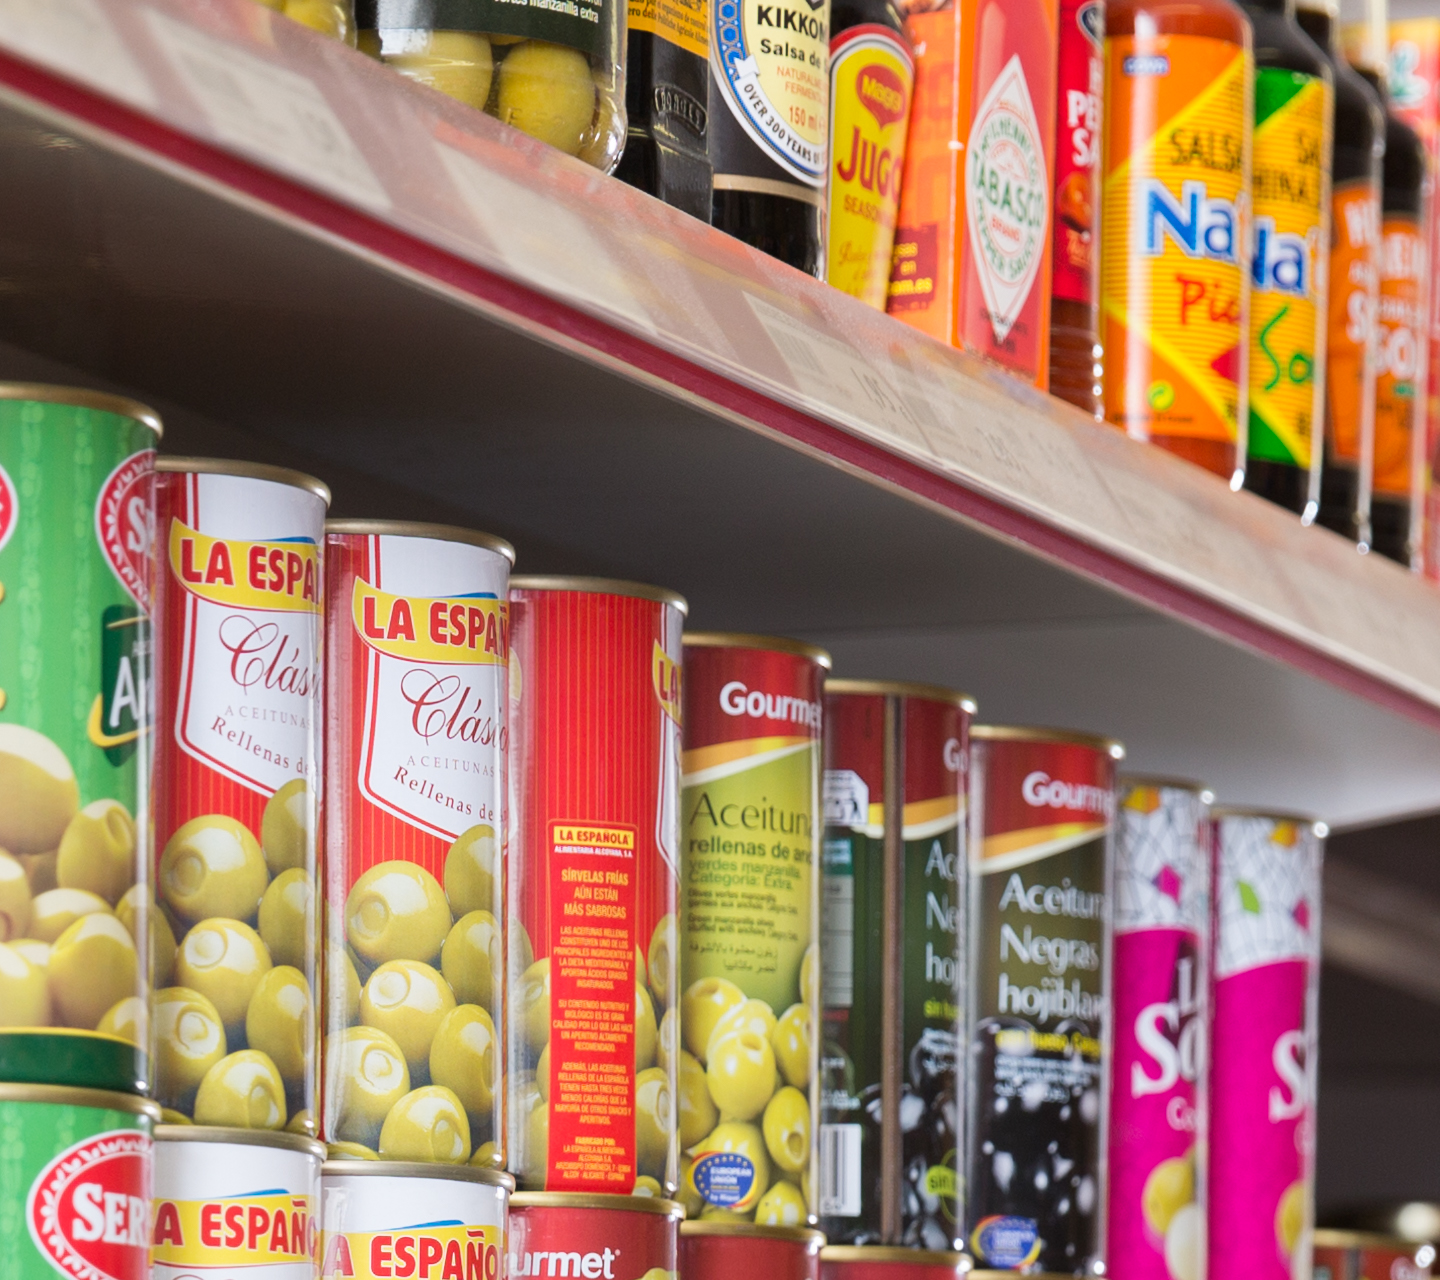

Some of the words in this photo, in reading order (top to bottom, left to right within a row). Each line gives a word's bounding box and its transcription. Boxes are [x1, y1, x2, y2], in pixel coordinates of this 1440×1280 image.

[580, 5, 598, 23] extra
[760, 39, 804, 62] Salsa
[744, 83, 765, 116] OVER
[765, 115, 785, 141] 300
[787, 134, 812, 162] YEARS
[789, 106, 806, 126] 150
[181, 538, 234, 586] LA
[363, 596, 416, 641] LA
[210, 716, 290, 770] Rellenas
[296, 757, 311, 775] de
[406, 755, 495, 778] ACEITUNAS
[393, 765, 473, 816] Rellenas
[478, 803, 494, 822] de
[560, 830, 573, 841] LA
[577, 830, 629, 845] ESPAÑOLA
[689, 836, 766, 859] rellenas
[771, 840, 790, 859] de
[561, 867, 604, 884] SÍRVELAS
[606, 870, 629, 886] FRÍAS
[574, 886, 591, 900] AÚN
[594, 887, 618, 901] ESTÁN
[564, 903, 583, 916] MÁS
[586, 905, 626, 919] SABROSAS
[999, 924, 1099, 974] Negras
